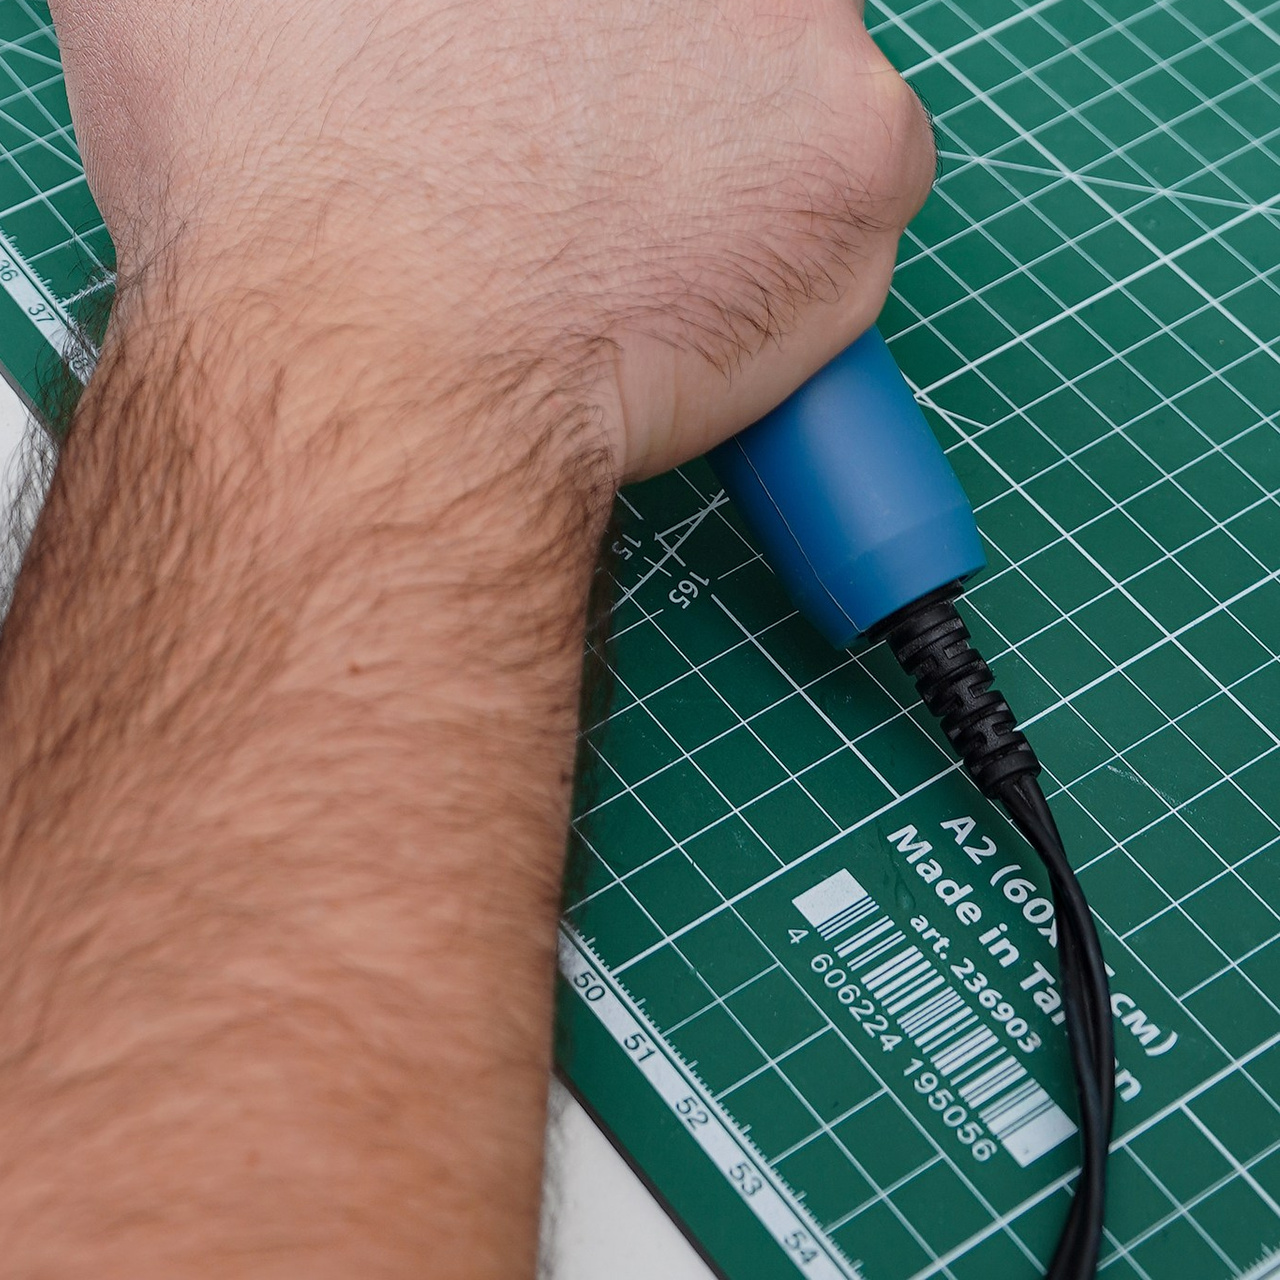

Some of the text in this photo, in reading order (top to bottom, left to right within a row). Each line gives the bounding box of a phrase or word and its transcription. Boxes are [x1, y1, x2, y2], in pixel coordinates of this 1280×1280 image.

[28, 302, 55, 323] 37
[612, 533, 642, 560] 15
[669, 571, 710, 609] 165
[940, 816, 997, 865] A2
[886, 824, 1142, 1102] Made in Tan
[573, 971, 606, 1002] 50
[910, 915, 1043, 1054] art. 236903
[623, 1033, 656, 1062] 51
[788, 928, 998, 1162] 4 606224 195056
[675, 1096, 709, 1130] 52
[729, 1162, 763, 1196] 53
[783, 1231, 818, 1264] 54
